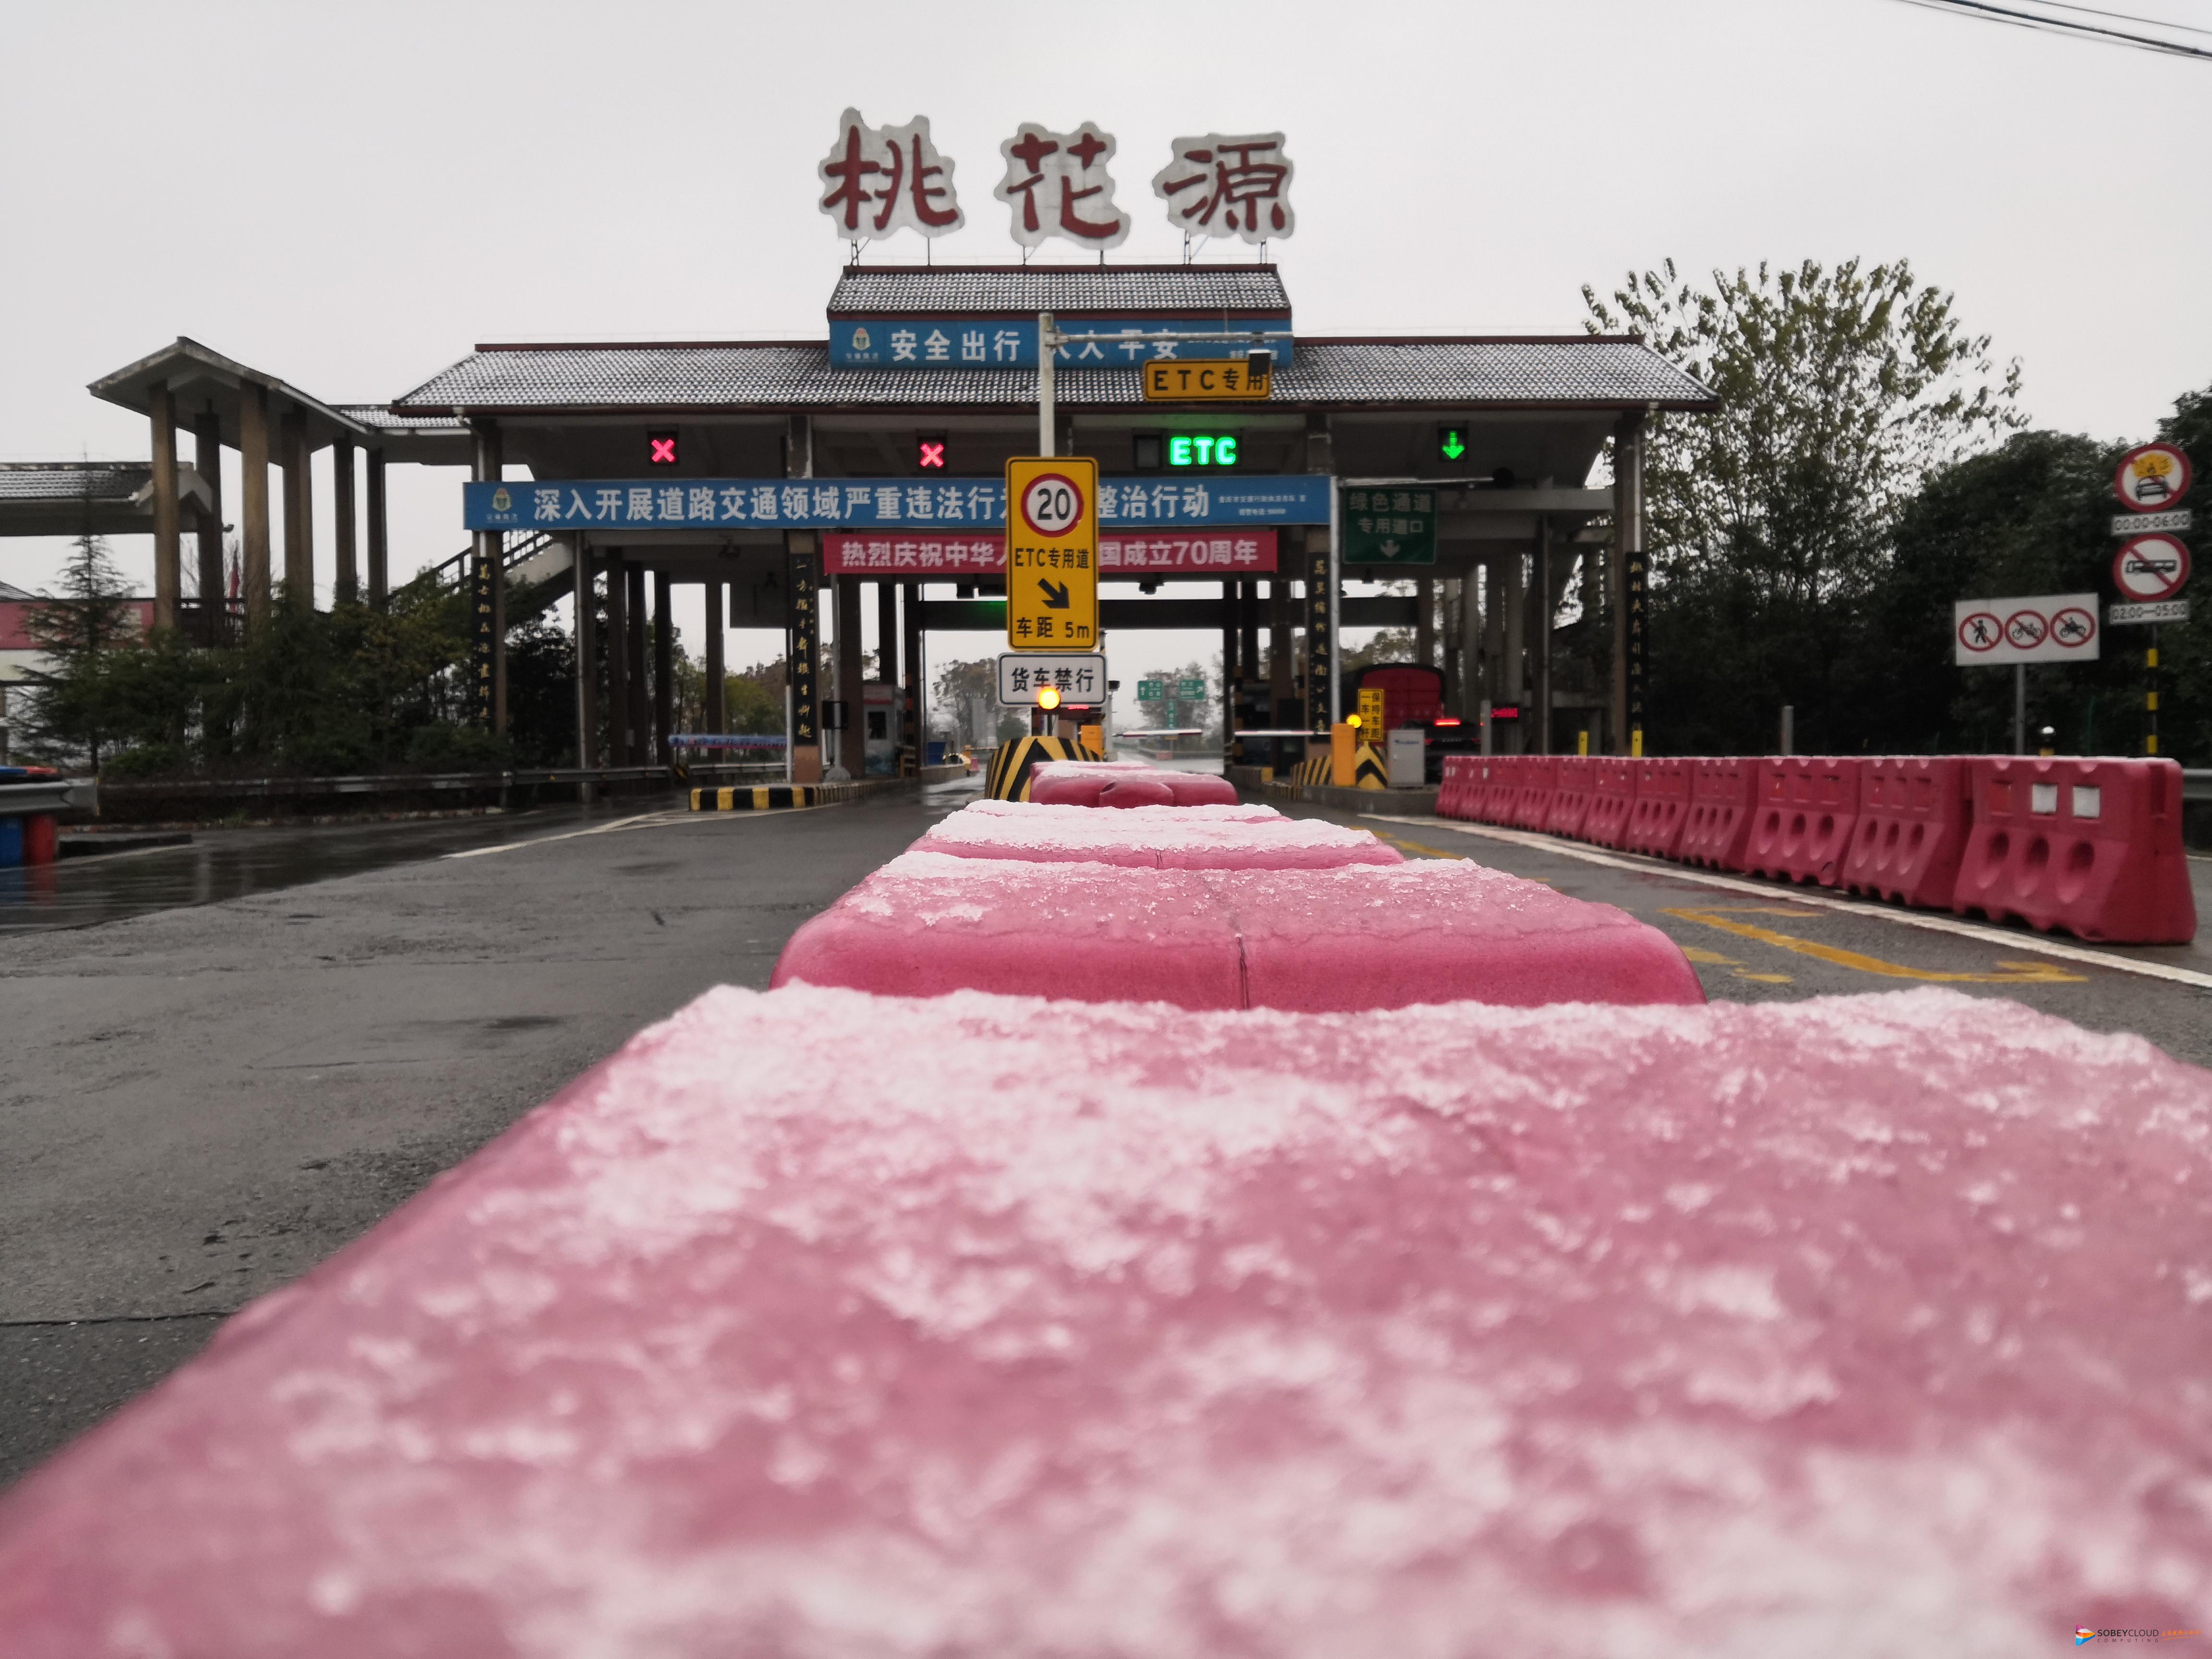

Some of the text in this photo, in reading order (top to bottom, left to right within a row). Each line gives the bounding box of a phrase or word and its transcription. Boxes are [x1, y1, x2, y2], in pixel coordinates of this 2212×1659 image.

[823, 124, 1287, 238] 桃花源
[890, 329, 1021, 362] 安全出行
[1154, 368, 1264, 391] ETC专用
[1170, 437, 1236, 465] ETC
[1037, 488, 1071, 520] 20
[1015, 548, 1090, 569] ETC专用道
[1016, 617, 1090, 638] 车距 5m
[1011, 667, 1094, 693] 货车禁行
